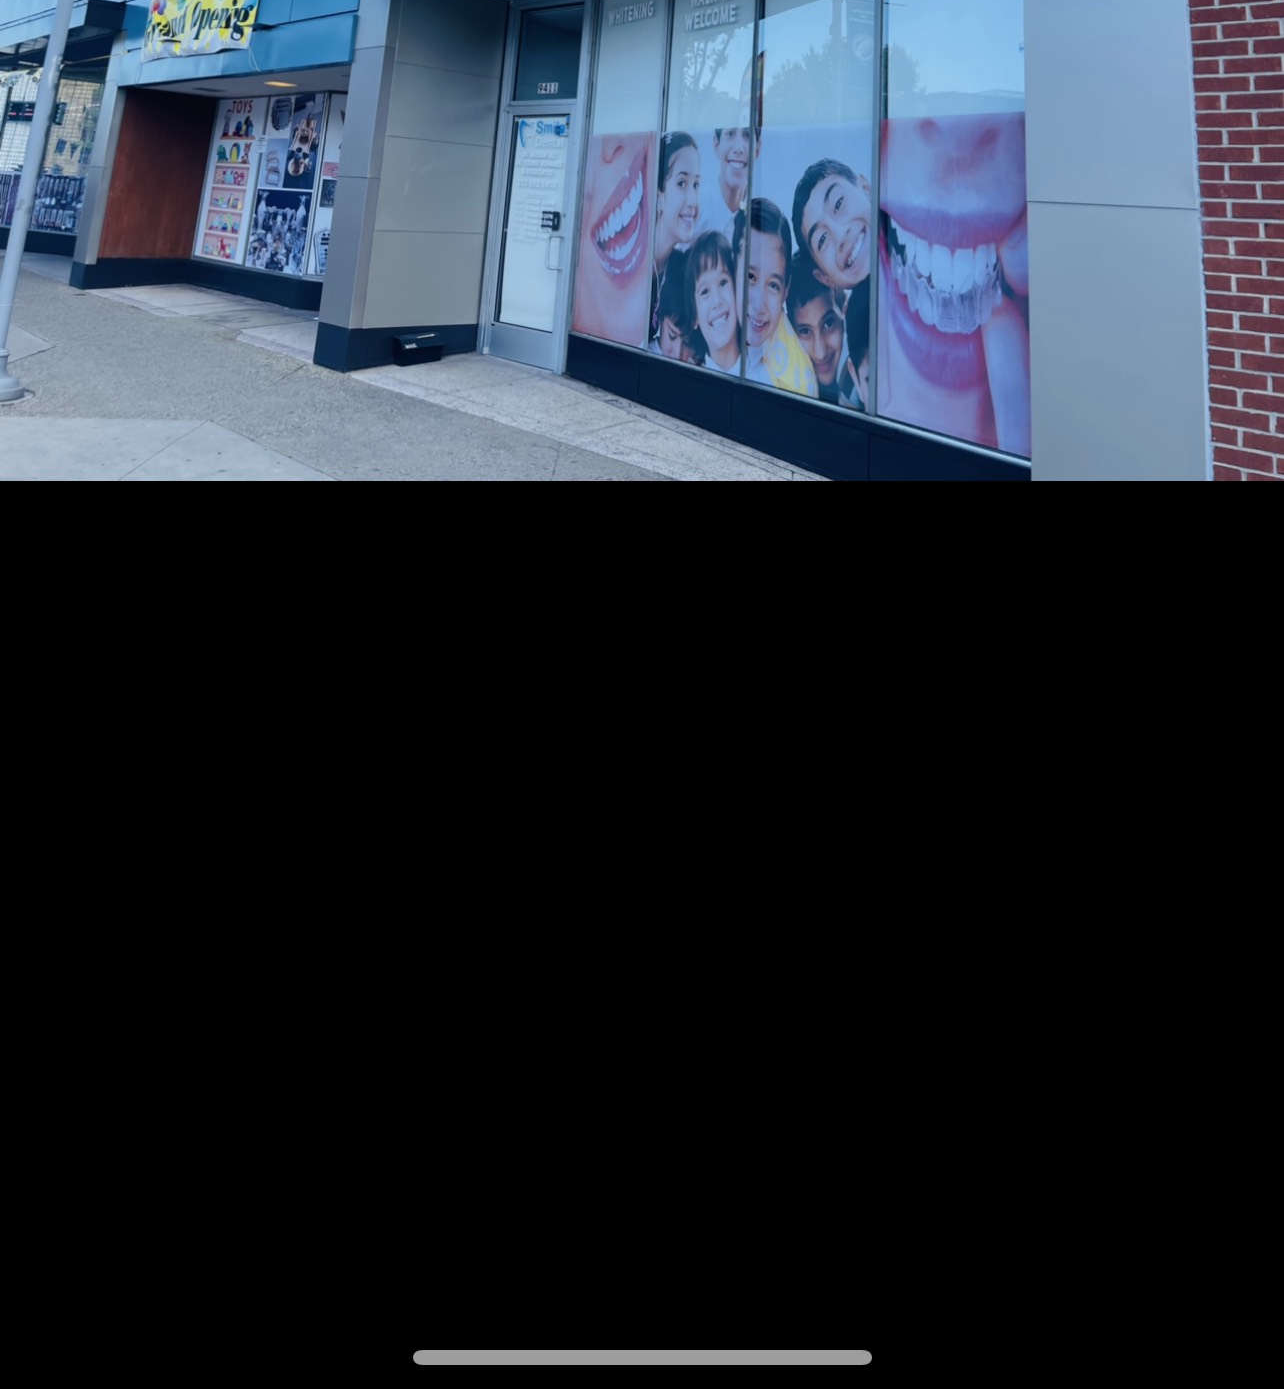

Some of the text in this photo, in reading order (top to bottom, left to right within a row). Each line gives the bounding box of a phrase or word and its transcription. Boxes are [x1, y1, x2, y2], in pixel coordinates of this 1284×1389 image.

[608, 1, 654, 26] WHITENING
[684, 4, 736, 32] WELCOME
[232, 99, 253, 114] TOYS
